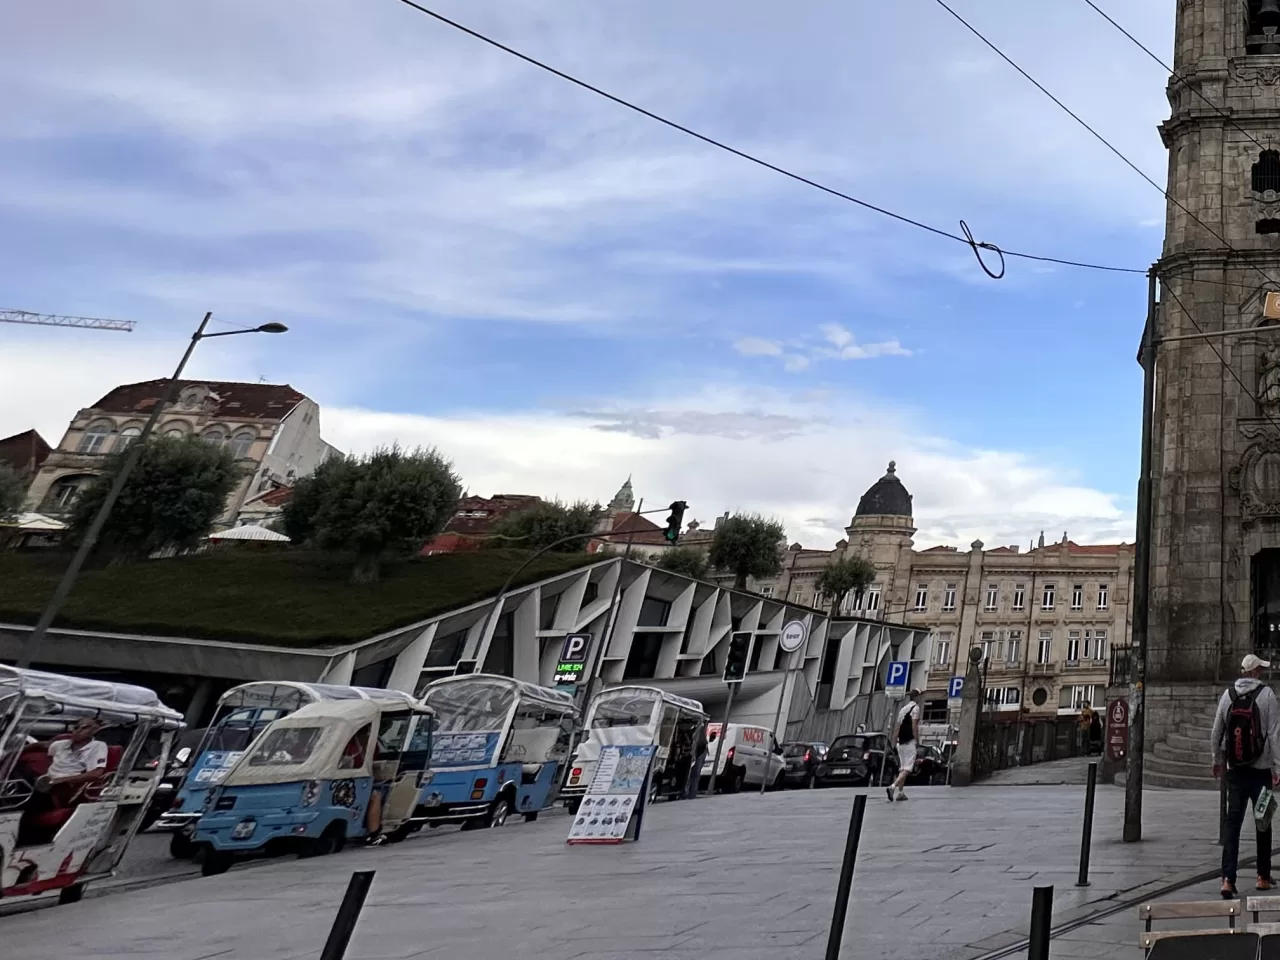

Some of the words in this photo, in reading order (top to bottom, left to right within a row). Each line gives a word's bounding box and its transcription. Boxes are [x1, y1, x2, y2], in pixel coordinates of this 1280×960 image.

[566, 637, 584, 659] P
[890, 663, 903, 684] P
[952, 678, 963, 696] P
